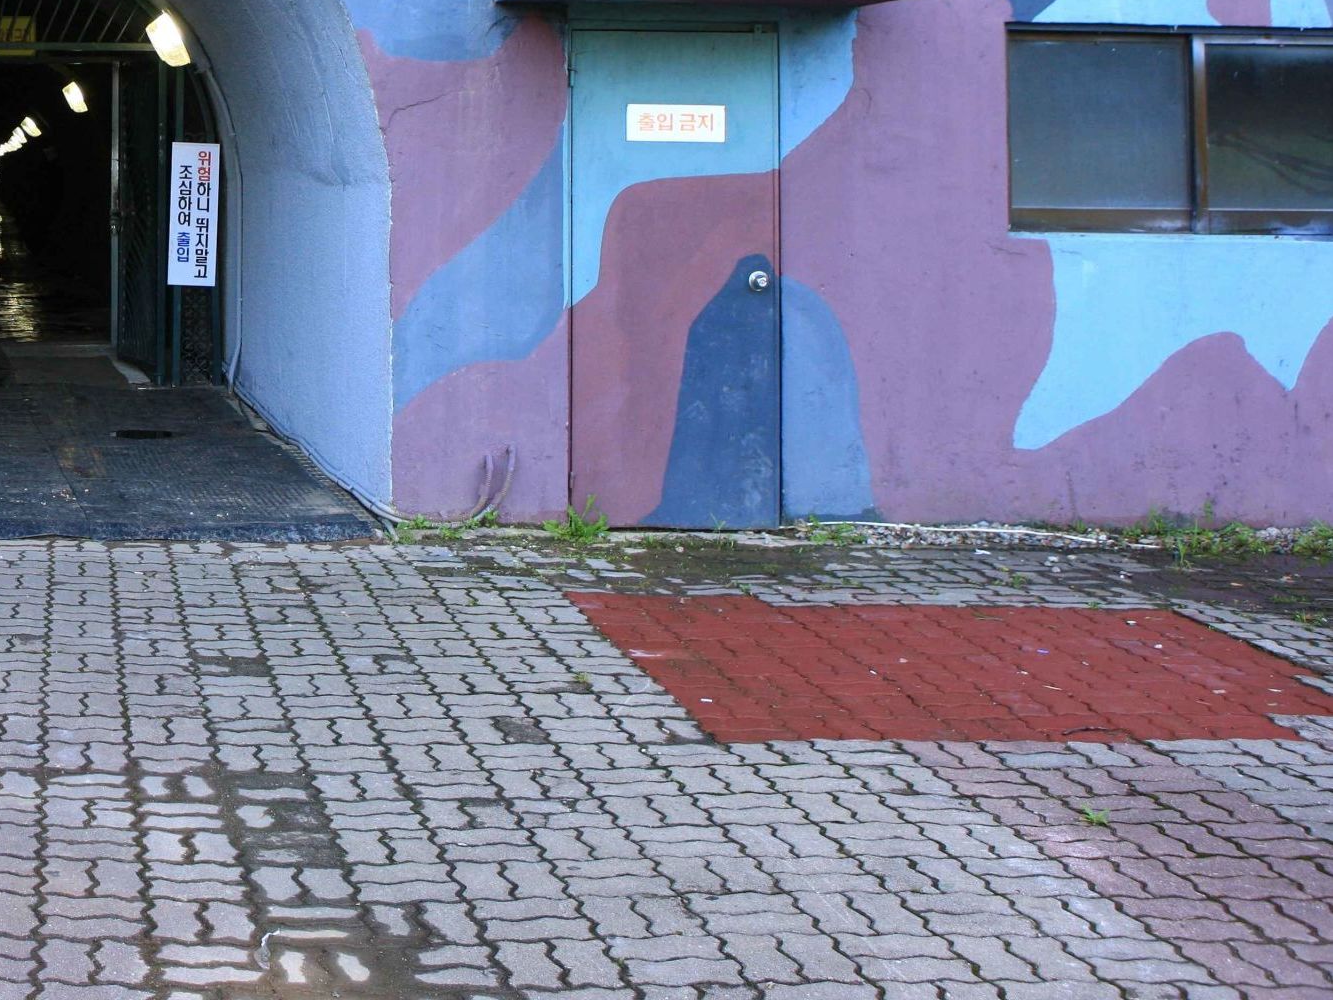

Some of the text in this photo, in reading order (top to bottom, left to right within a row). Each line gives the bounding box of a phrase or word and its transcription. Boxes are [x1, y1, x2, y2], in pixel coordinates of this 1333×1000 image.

[176, 164, 193, 263] 조심하여 출입
[194, 150, 212, 279] 위험하니 뛰지말고
